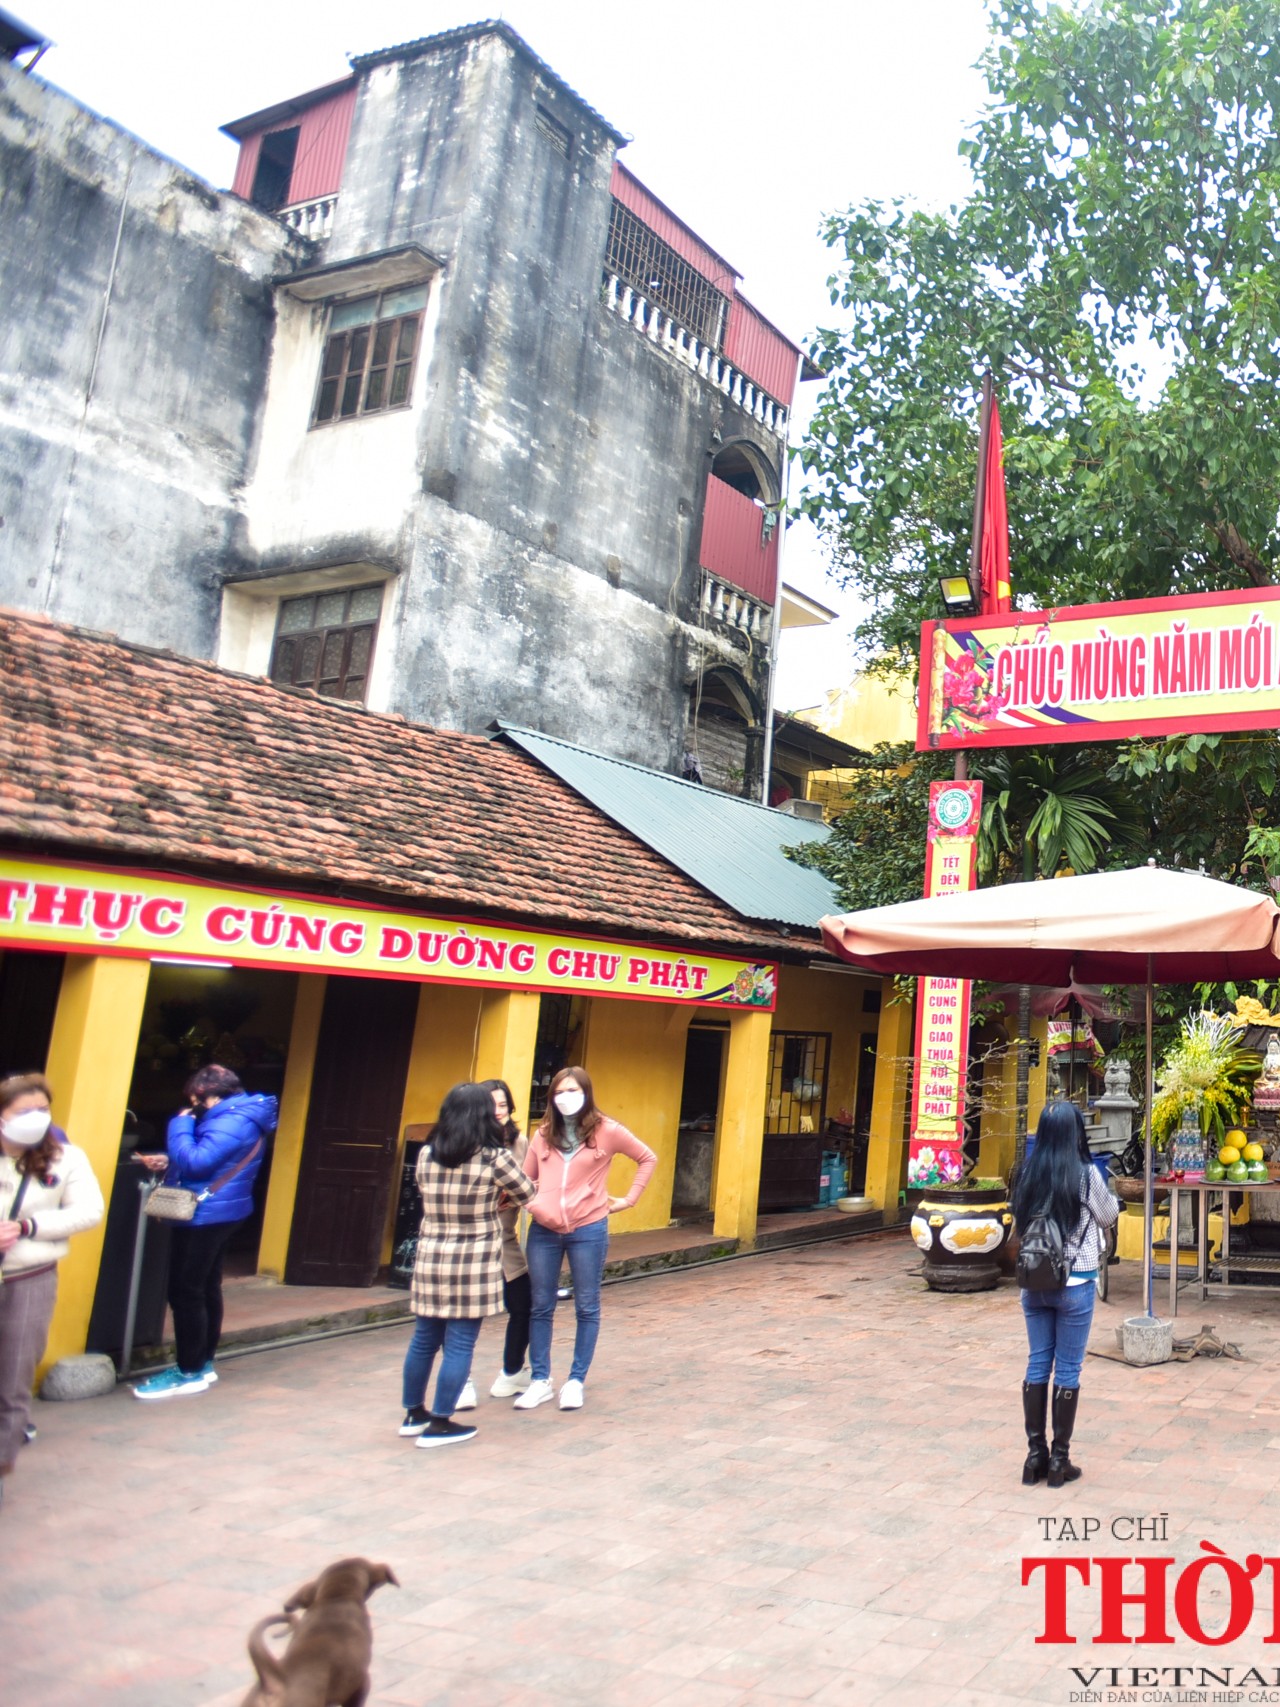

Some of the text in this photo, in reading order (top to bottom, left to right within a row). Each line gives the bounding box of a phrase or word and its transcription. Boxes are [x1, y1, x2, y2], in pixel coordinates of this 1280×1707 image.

[1000, 624, 1064, 708] CHÚC
[1070, 627, 1147, 700] MỪNG
[1152, 621, 1211, 694] NĂM
[1218, 612, 1273, 690] MỚI
[942, 854, 960, 868] TẾT
[940, 872, 960, 885] ĐẾN
[206, 904, 364, 957] CÚNG
[380, 923, 535, 973] DƯỜNG
[547, 947, 619, 982] CHƯ
[627, 957, 708, 996] PHẬT
[929, 996, 957, 1007] CUNG
[931, 1011, 953, 1025] ĐÓN
[929, 1031, 953, 1043] GIAO
[927, 1047, 953, 1060] THỪA
[924, 1101, 951, 1117] PHẬT
